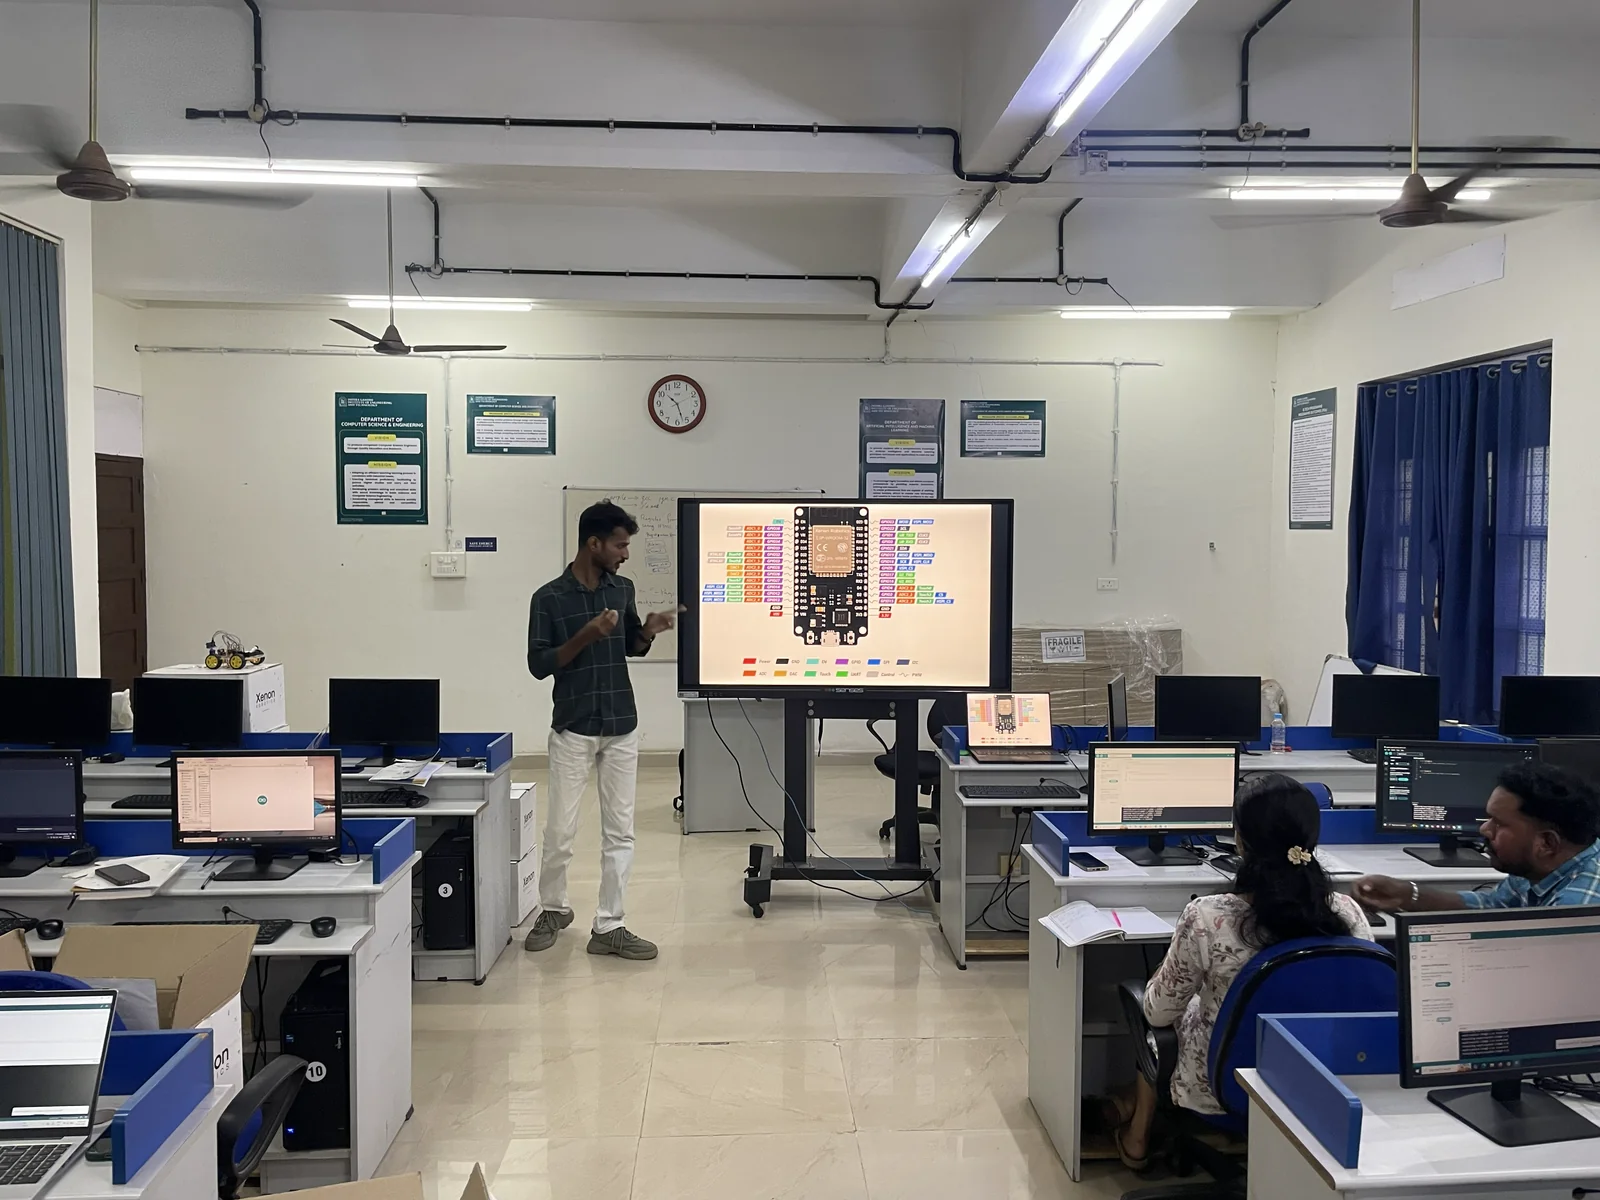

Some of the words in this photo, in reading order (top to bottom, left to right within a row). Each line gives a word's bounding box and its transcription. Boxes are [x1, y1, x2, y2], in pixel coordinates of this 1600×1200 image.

[1047, 636, 1082, 646] FRAGILE
[256, 689, 275, 704] Xenon
[523, 871, 534, 887] Xenon
[214, 1048, 229, 1069] on
[216, 1064, 230, 1079] ICS
[308, 1066, 323, 1078] 10
